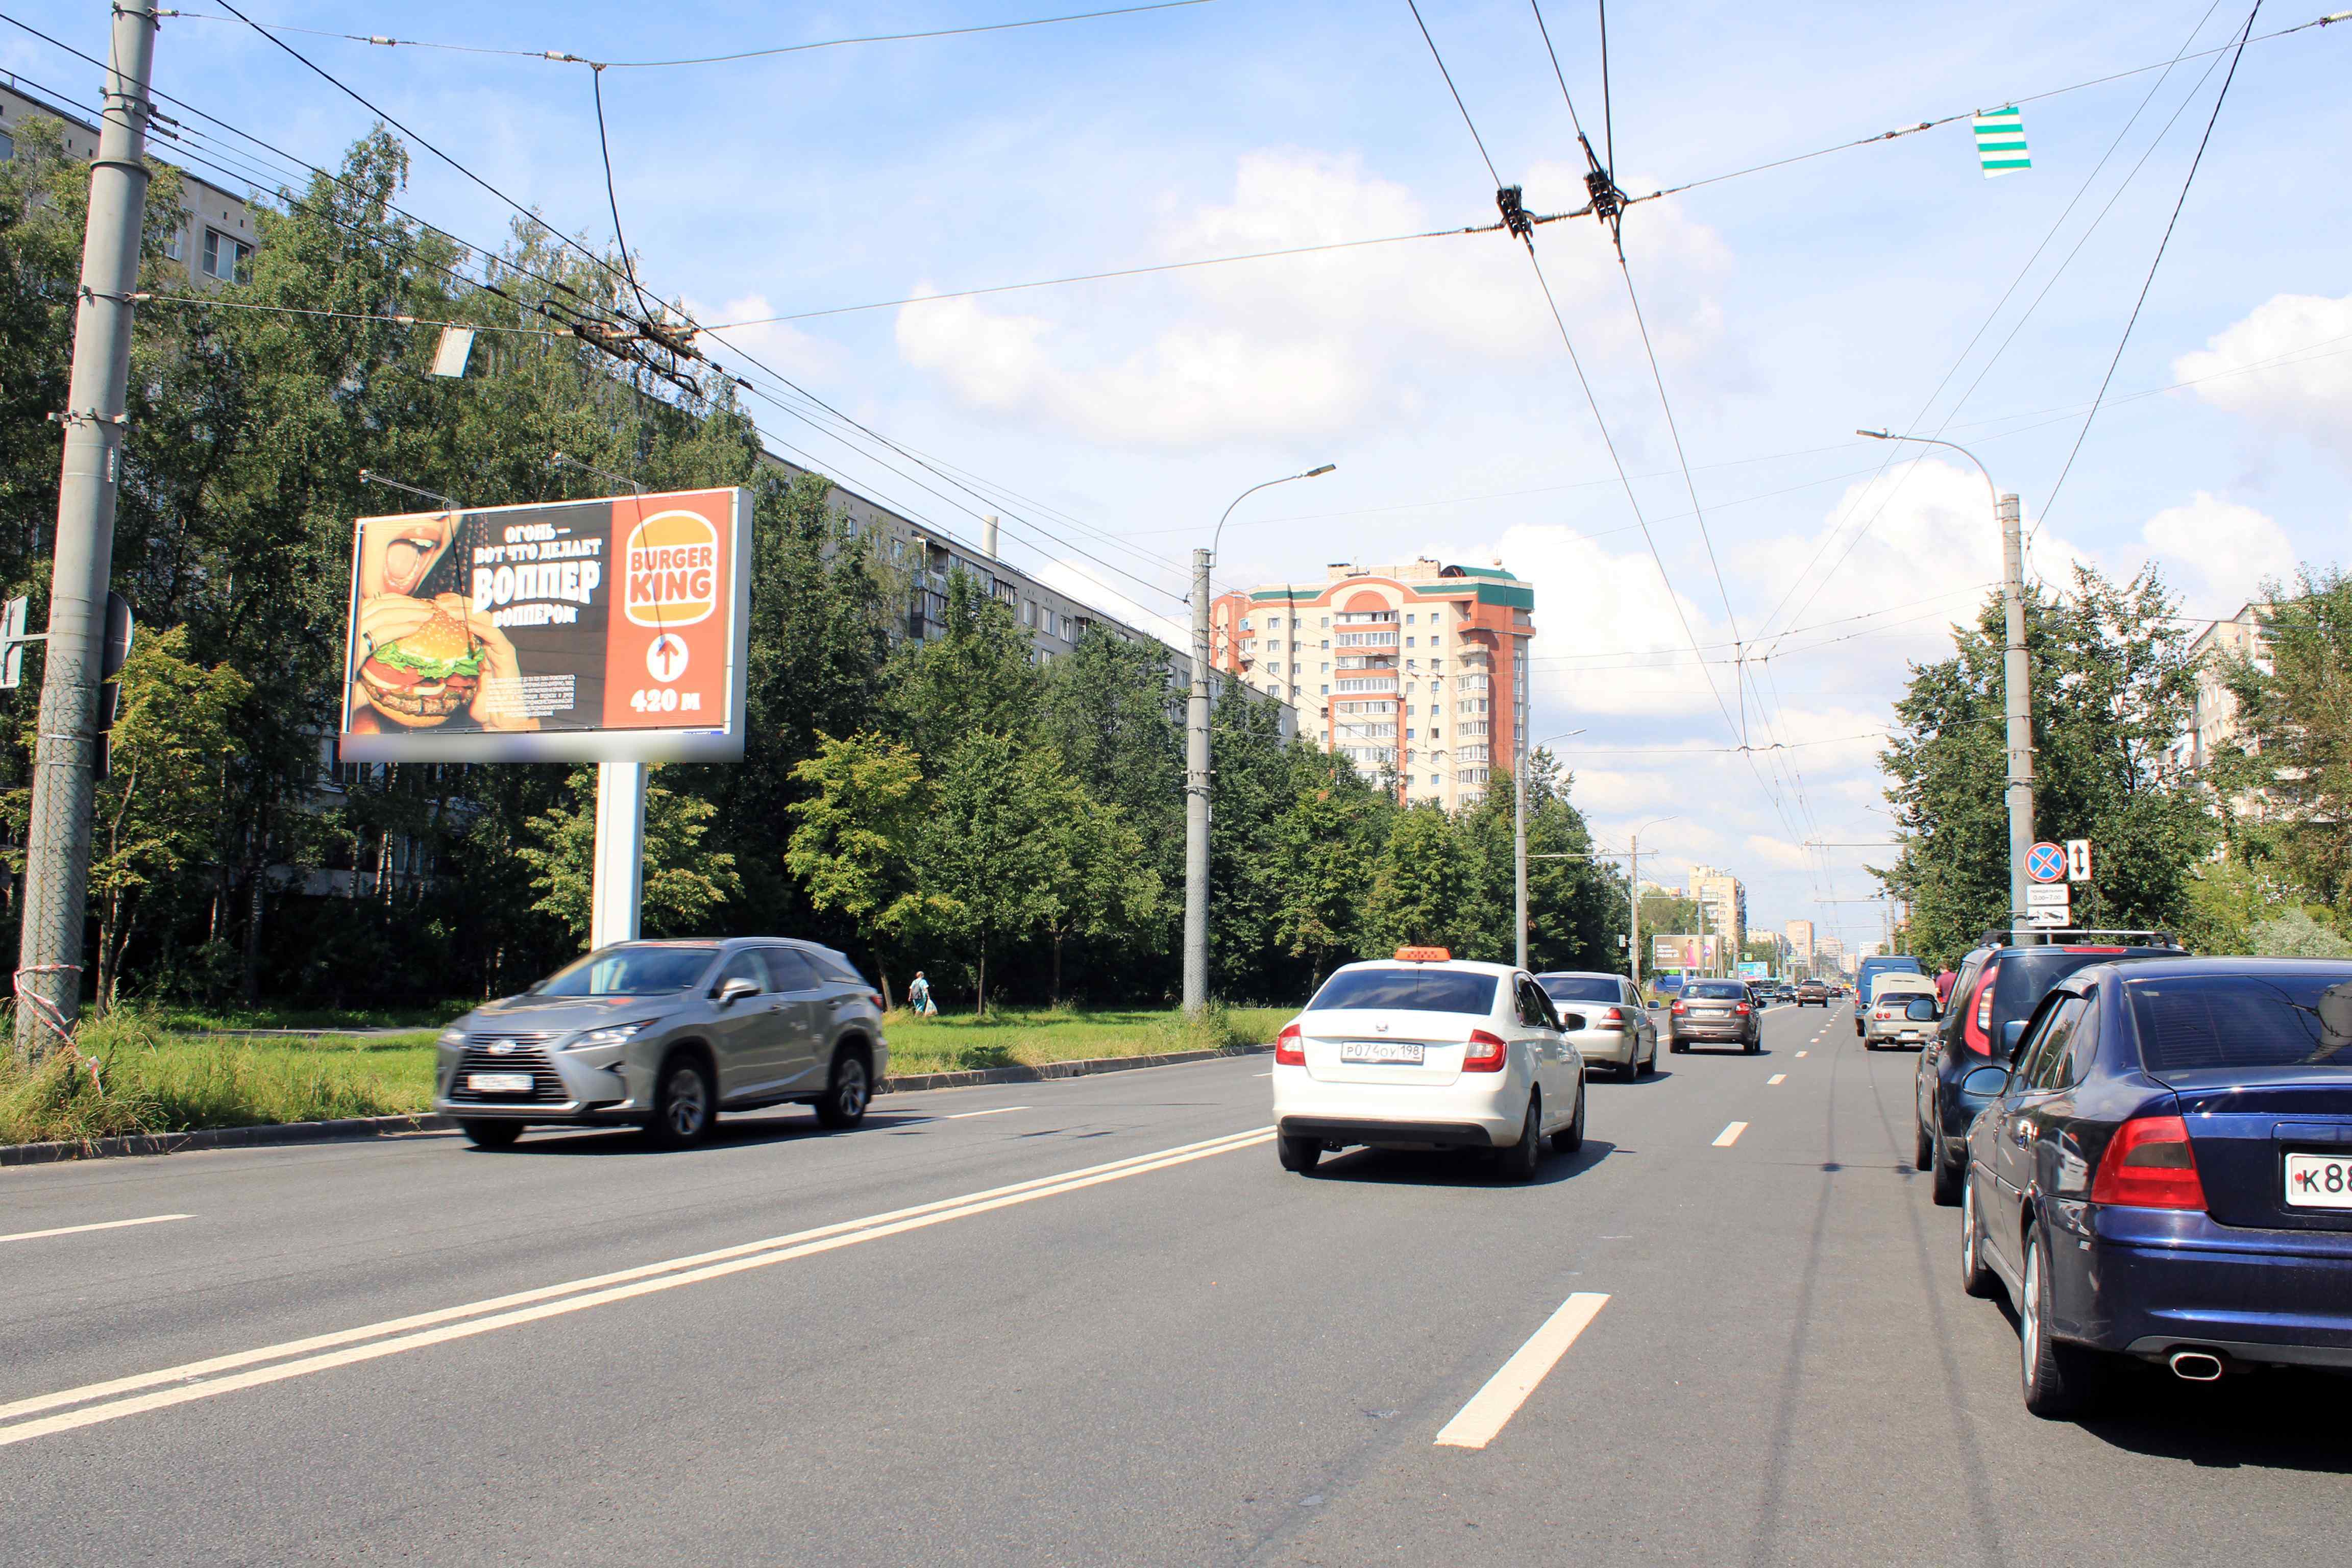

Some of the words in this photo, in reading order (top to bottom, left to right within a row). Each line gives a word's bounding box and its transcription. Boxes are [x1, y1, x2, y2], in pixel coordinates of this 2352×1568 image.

[505, 523, 556, 543] ОГОНЬ
[473, 546, 505, 564] ВОТ
[506, 543, 538, 561] ЧТО
[538, 538, 602, 560] ДЕЛАЕТ
[631, 547, 712, 572] BURGER
[472, 560, 601, 615] ВОППЕР
[630, 569, 712, 603] KING
[492, 603, 578, 628] ВОППЕРОМ
[630, 688, 678, 712] 420
[1401, 1045, 1419, 1056] 198
[2302, 1163, 2352, 1193] К8
